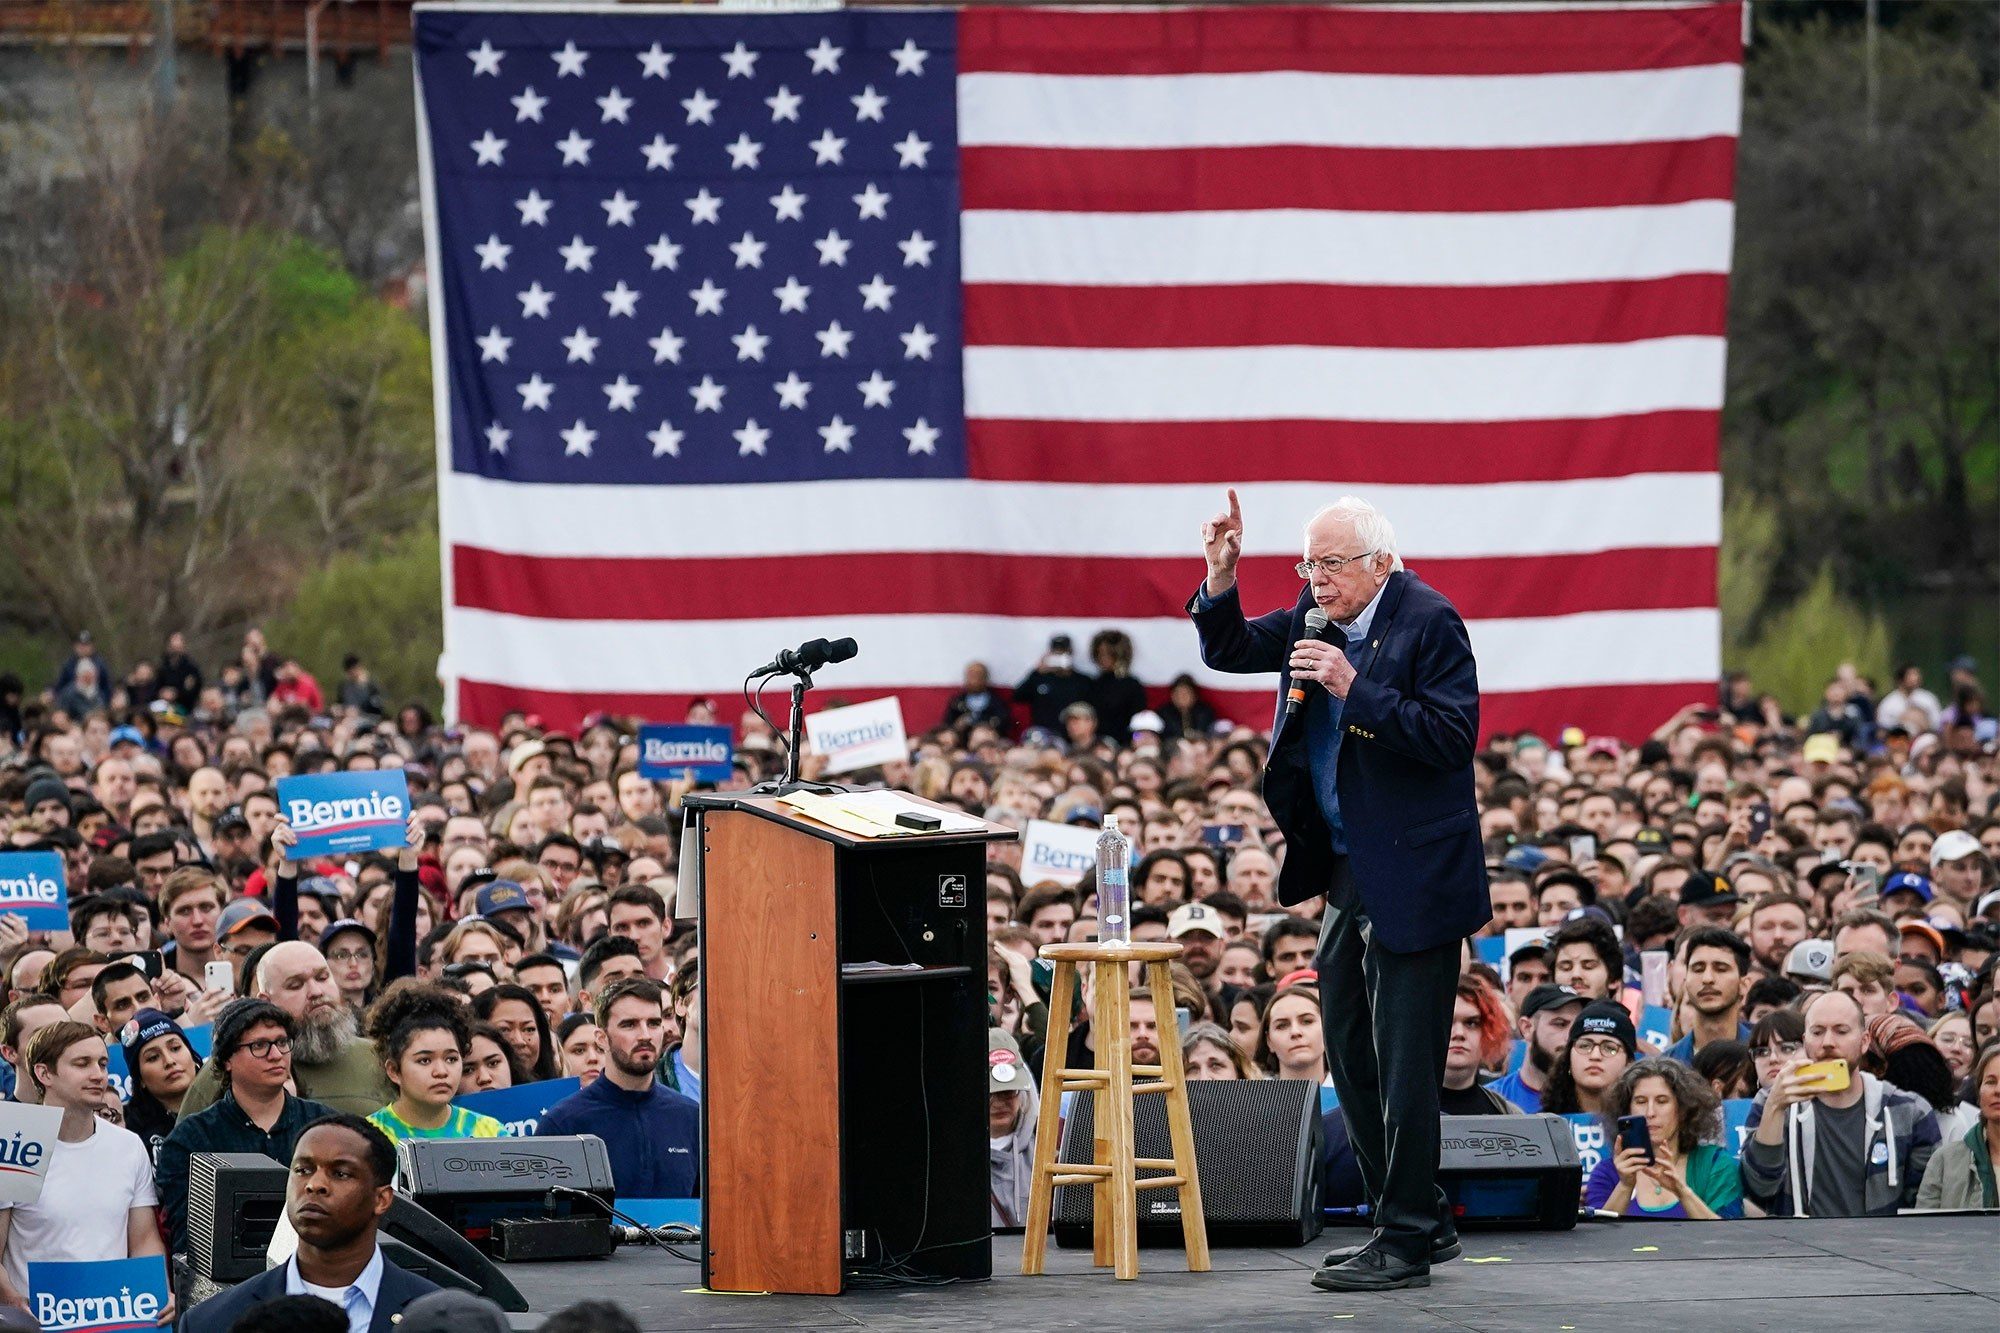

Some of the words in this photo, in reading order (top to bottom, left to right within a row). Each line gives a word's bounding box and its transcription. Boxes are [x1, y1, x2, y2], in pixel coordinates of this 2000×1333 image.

[817, 719, 895, 750] Bernie
[644, 738, 729, 761] Bernie
[288, 790, 402, 828] Bernie
[1033, 842, 1096, 871] Bern
[0, 872, 59, 903] rnie
[140, 1021, 170, 1038] Bernie
[1583, 1017, 1617, 1029] Bernie
[1440, 1137, 1517, 1152] mega
[443, 1157, 549, 1174] Omega
[36, 1286, 158, 1326] Bernie
